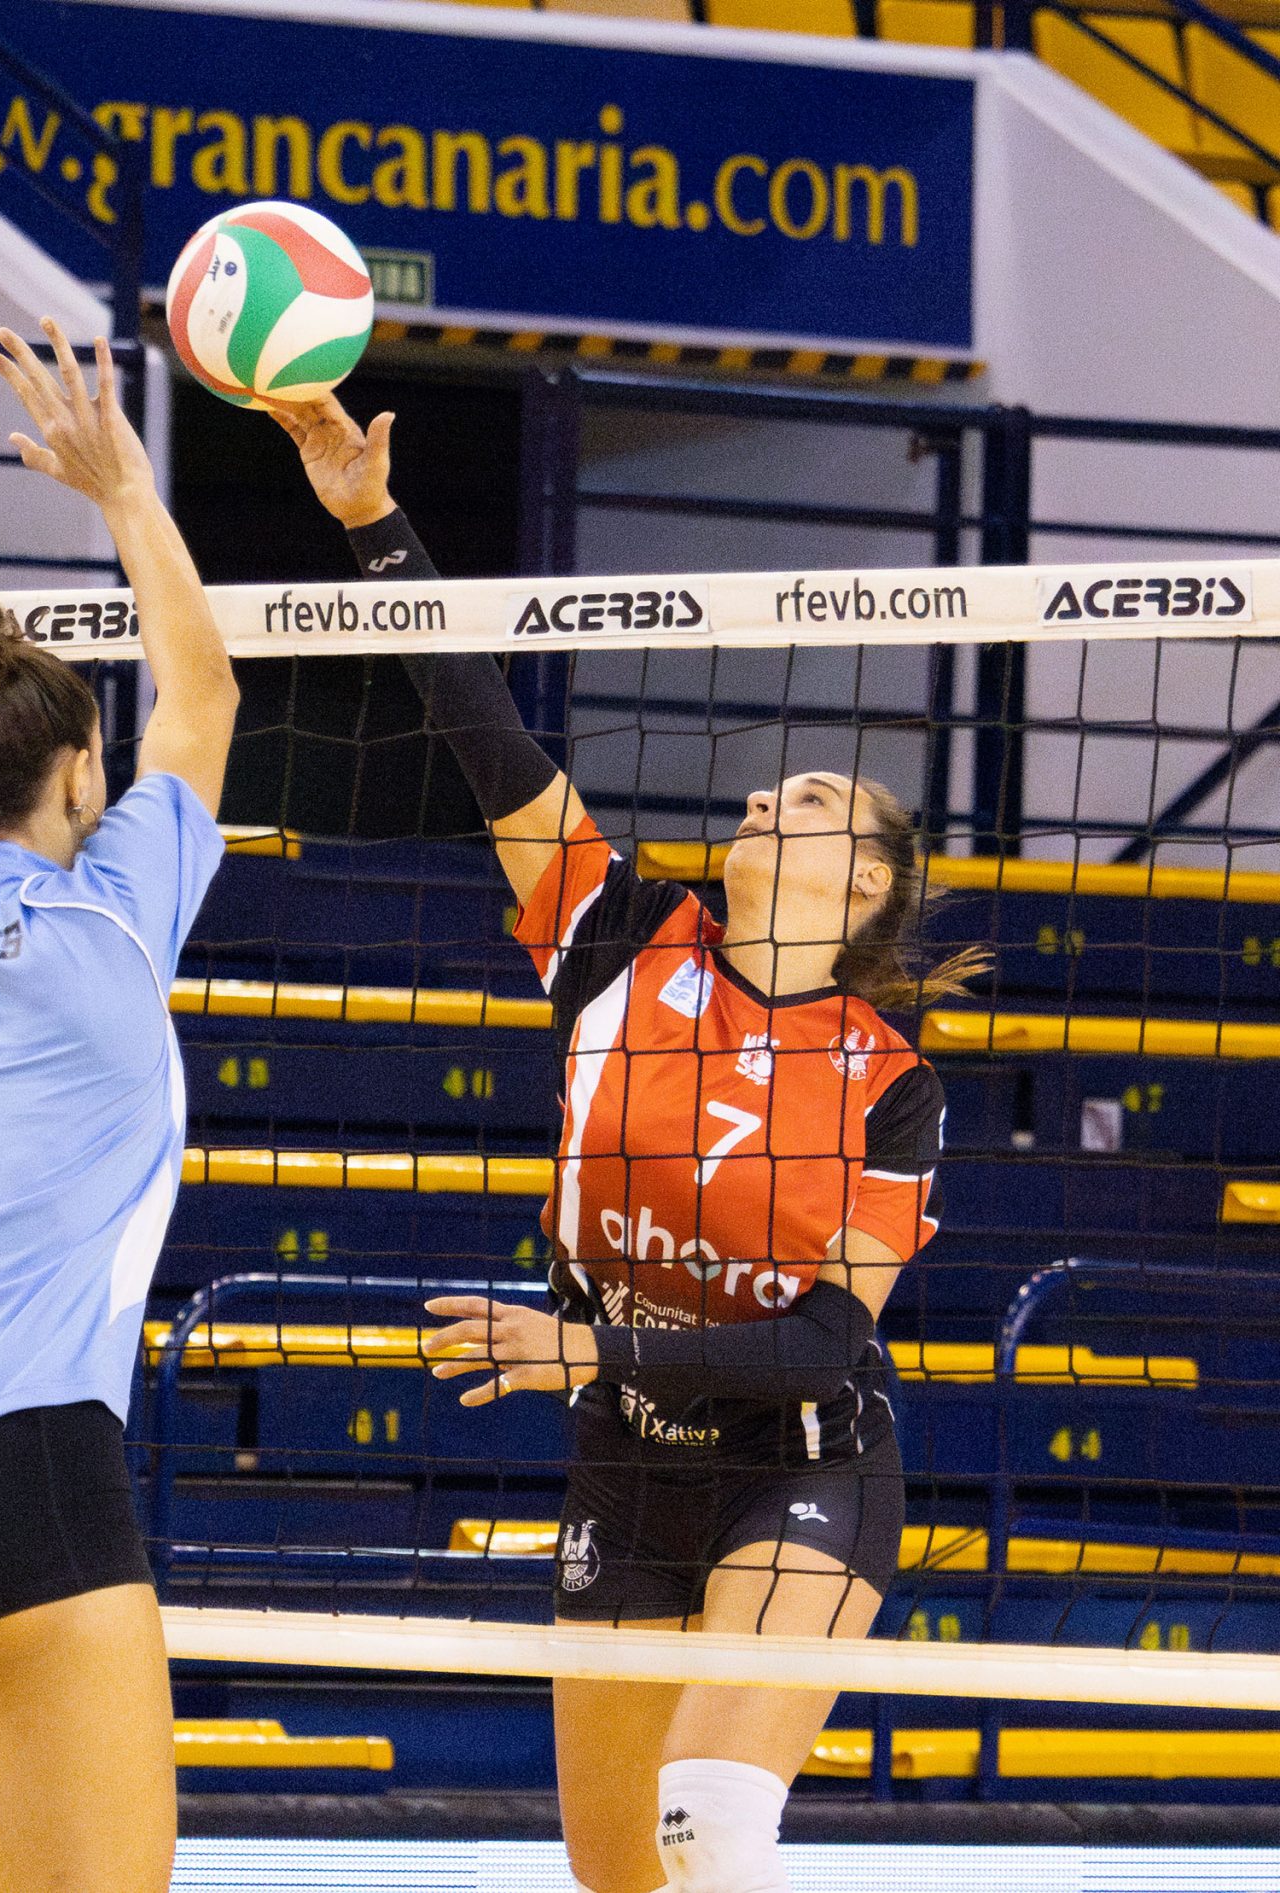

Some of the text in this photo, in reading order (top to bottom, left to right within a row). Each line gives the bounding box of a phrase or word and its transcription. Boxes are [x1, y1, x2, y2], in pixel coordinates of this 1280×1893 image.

[24, 601, 140, 641] CERBI
[265, 590, 447, 633] rfevb.com
[775, 578, 968, 624] rfevb.com
[694, 1100, 762, 1186] 7
[601, 1206, 800, 1309] ahora
[634, 1291, 697, 1326] Comunitat
